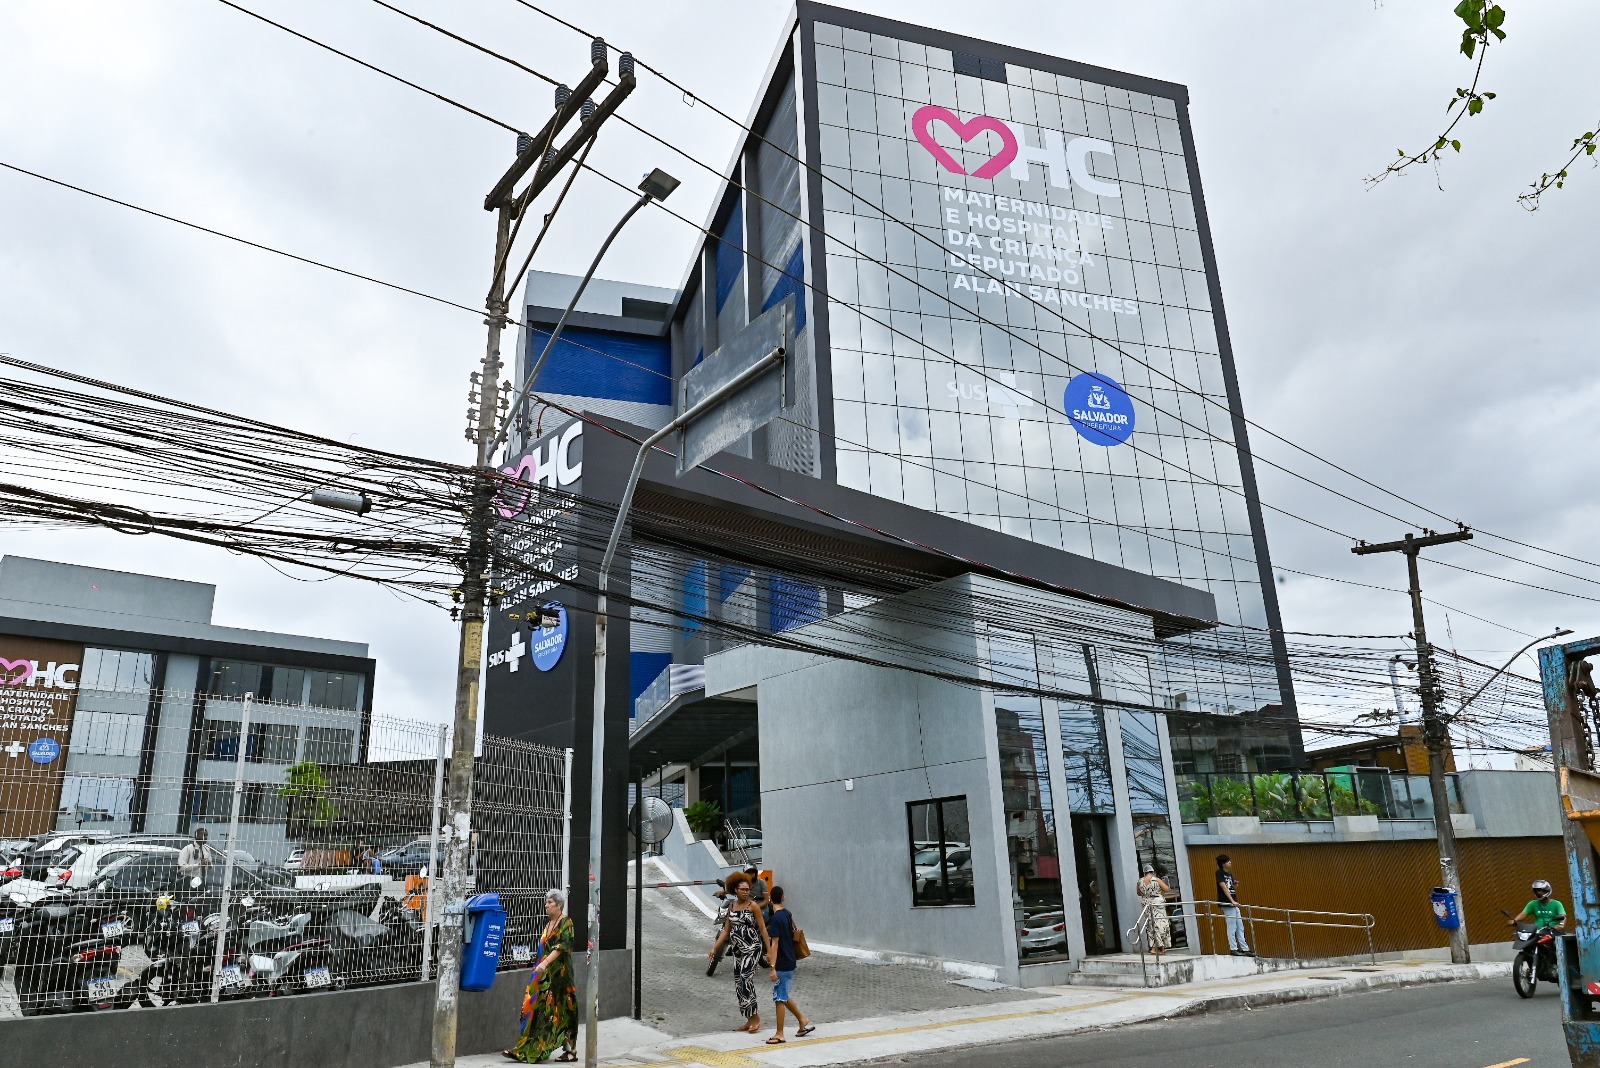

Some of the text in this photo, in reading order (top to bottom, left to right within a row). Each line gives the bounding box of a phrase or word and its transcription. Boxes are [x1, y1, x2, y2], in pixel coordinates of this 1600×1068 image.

[1004, 121, 1121, 198] HC
[944, 187, 1113, 230] MATERNIDADE
[946, 208, 1081, 244] E HOSPITAL
[947, 228, 1095, 268] DA CRIANÇA
[950, 251, 1079, 285] DEPUTADO
[953, 274, 1138, 315] ALAN SANCHES
[947, 381, 986, 401] SUS
[1073, 409, 1128, 425] SALVADOR
[530, 420, 582, 506] HC
[500, 559, 553, 591] DEPUDO
[500, 588, 527, 612] ALAN
[535, 634, 562, 653] SALVADOR
[488, 650, 504, 668] SUS
[26, 660, 79, 690] HC
[1, 697, 52, 708] HOSPITAL
[8, 706, 54, 716] CRIANÇA
[0, 713, 45, 723] PUTADO
[20, 722, 68, 732] SANCHES
